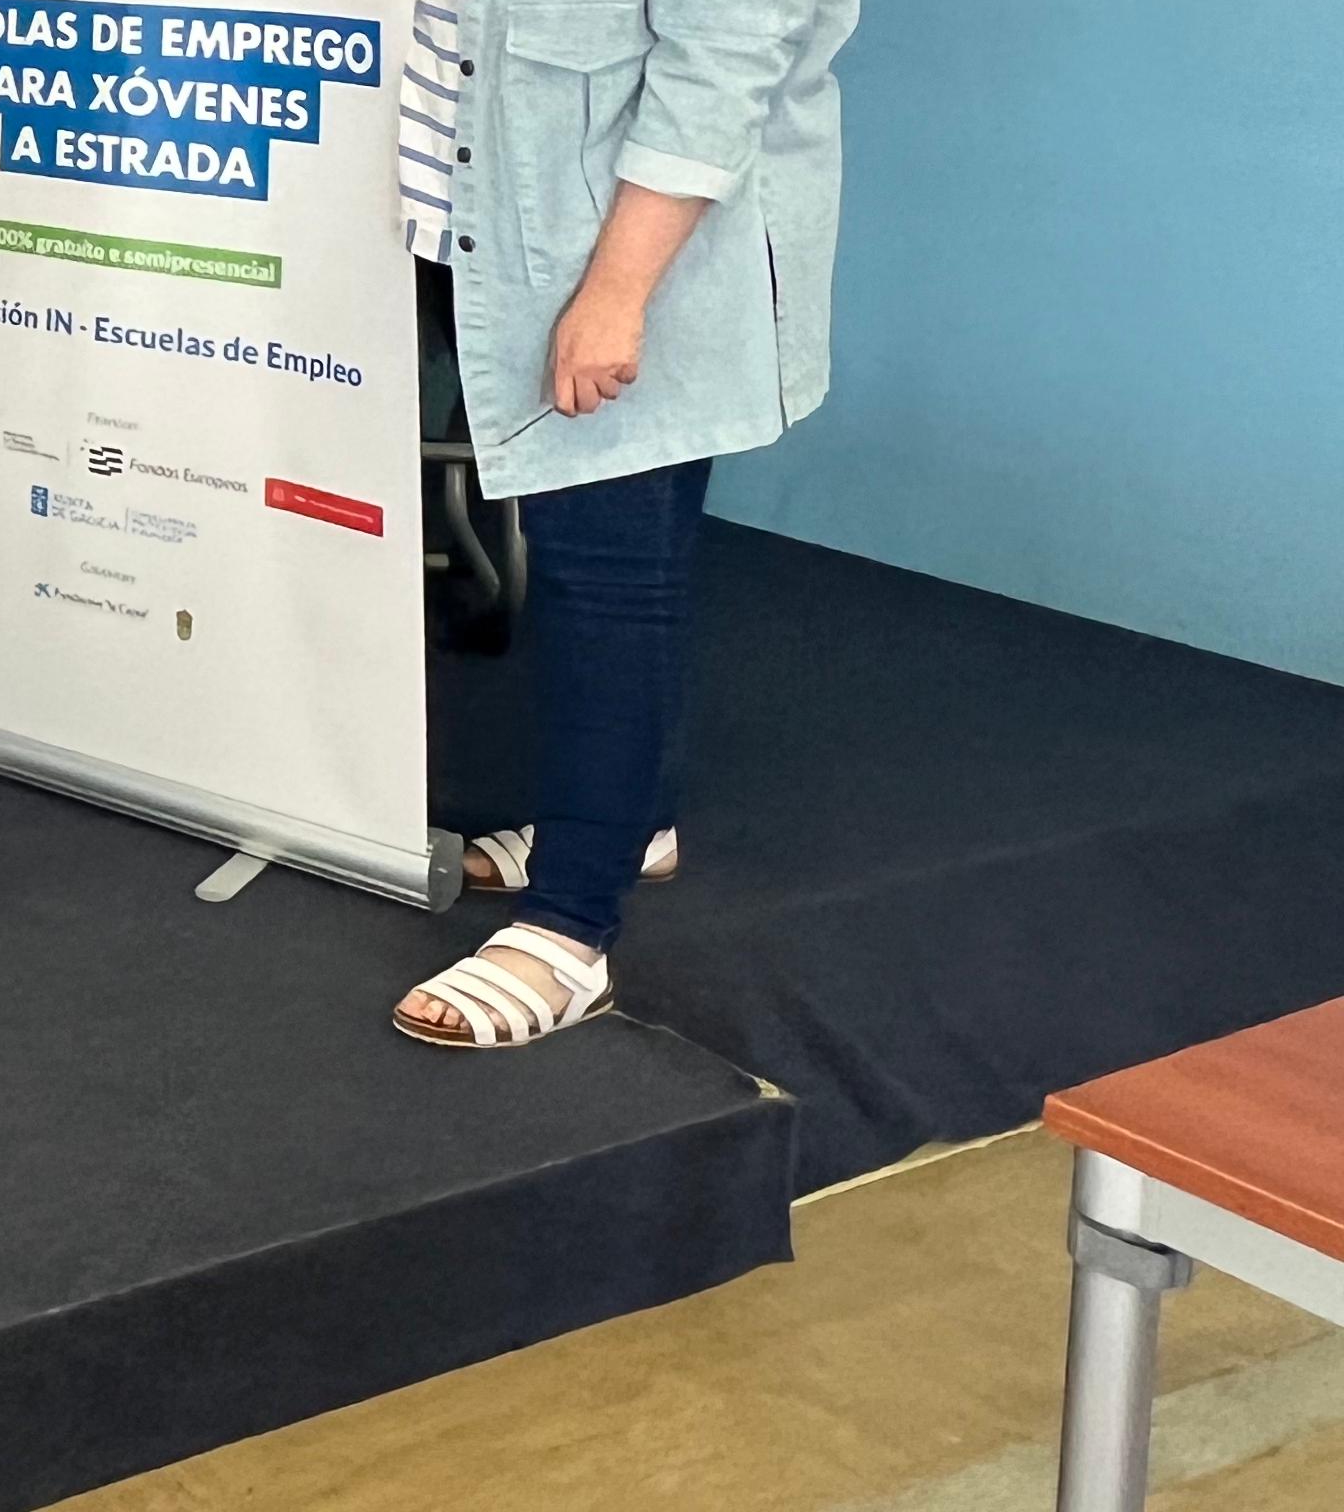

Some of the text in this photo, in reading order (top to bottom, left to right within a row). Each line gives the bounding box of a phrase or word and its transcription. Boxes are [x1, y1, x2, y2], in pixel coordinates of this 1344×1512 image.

[92, 14, 143, 55] DE
[161, 18, 374, 74] EMPREGO
[89, 66, 308, 130] XÓVENES
[11, 125, 255, 187] A ESTRADA
[36, 237, 105, 262] gratuito
[109, 250, 121, 263] e
[124, 248, 275, 283] semipresencial
[46, 308, 73, 336] IN
[94, 317, 215, 358] Escuelas
[222, 337, 259, 365] de
[267, 342, 363, 387] Empleo
